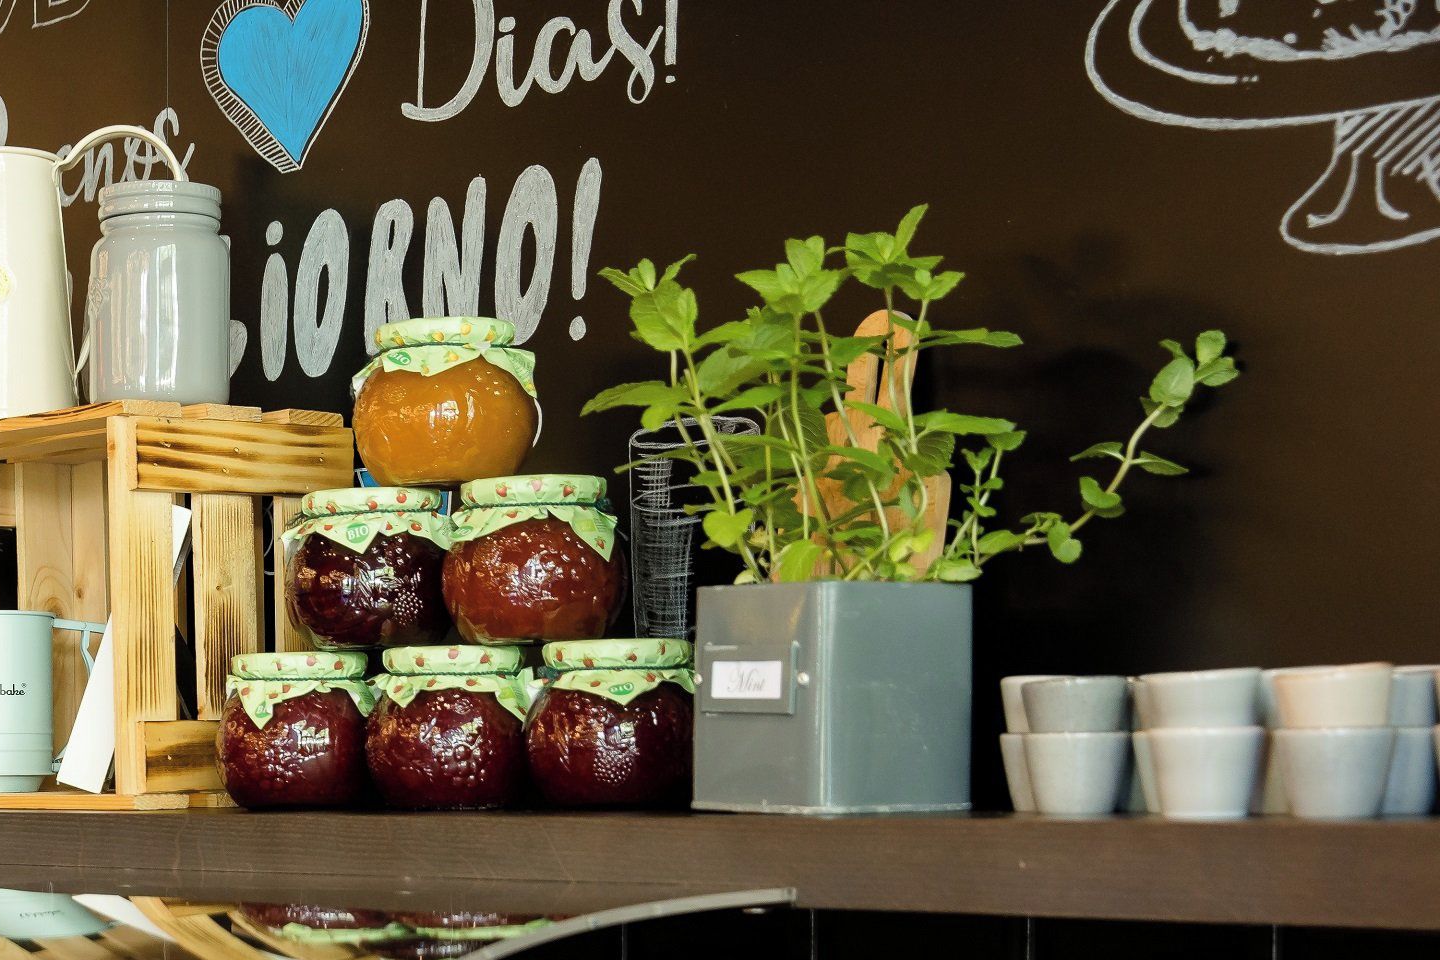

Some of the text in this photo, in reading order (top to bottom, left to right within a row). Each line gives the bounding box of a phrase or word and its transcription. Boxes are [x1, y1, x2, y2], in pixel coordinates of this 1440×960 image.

[401, 0, 678, 122] Dias!
[228, 157, 602, 382] iORNO!
[347, 526, 369, 540] BIO
